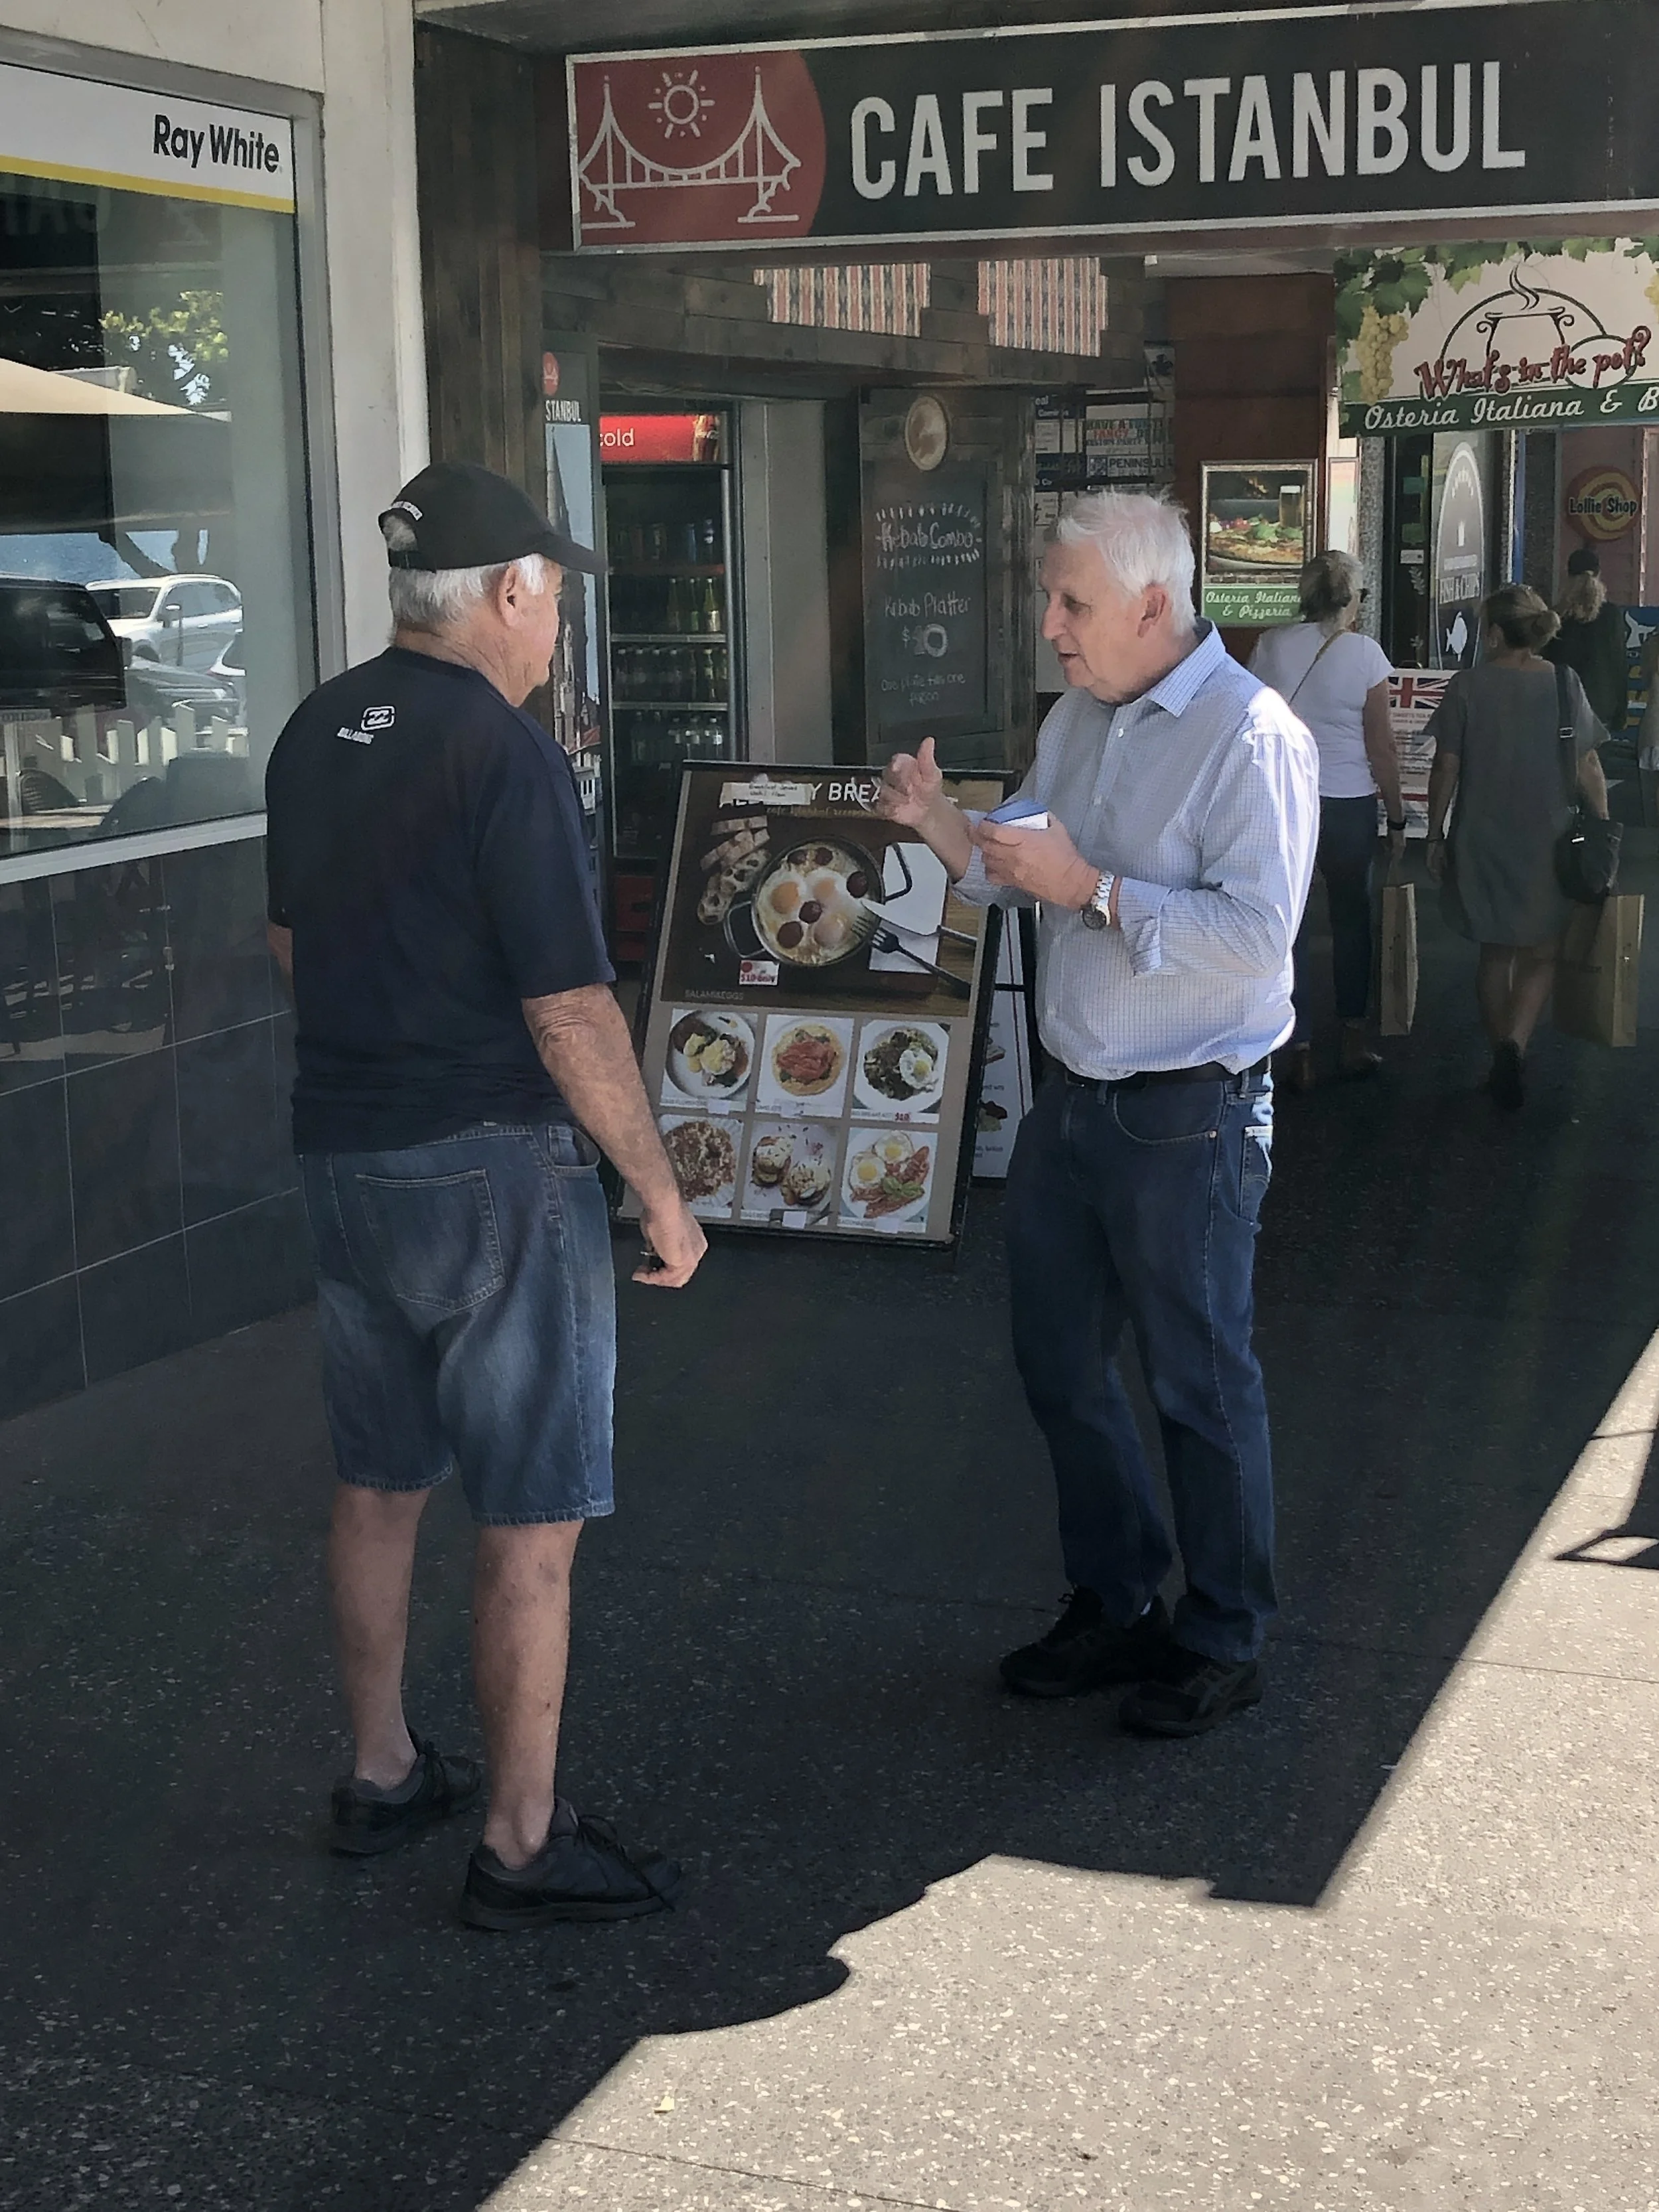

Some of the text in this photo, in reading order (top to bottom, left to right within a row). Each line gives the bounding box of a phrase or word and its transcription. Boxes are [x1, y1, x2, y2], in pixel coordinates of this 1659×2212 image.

[153, 114, 280, 173] Ray White
[851, 60, 1526, 200] CAFE ISTANBUL
[1550, 342, 1587, 384] the
[545, 400, 581, 422] STANBUL
[1364, 386, 1659, 431] Osteria Italiana & B
[1569, 494, 1638, 516] Lollie Shop
[1206, 591, 1250, 603] Osteria
[1222, 604, 1292, 620] & Pizzeria
